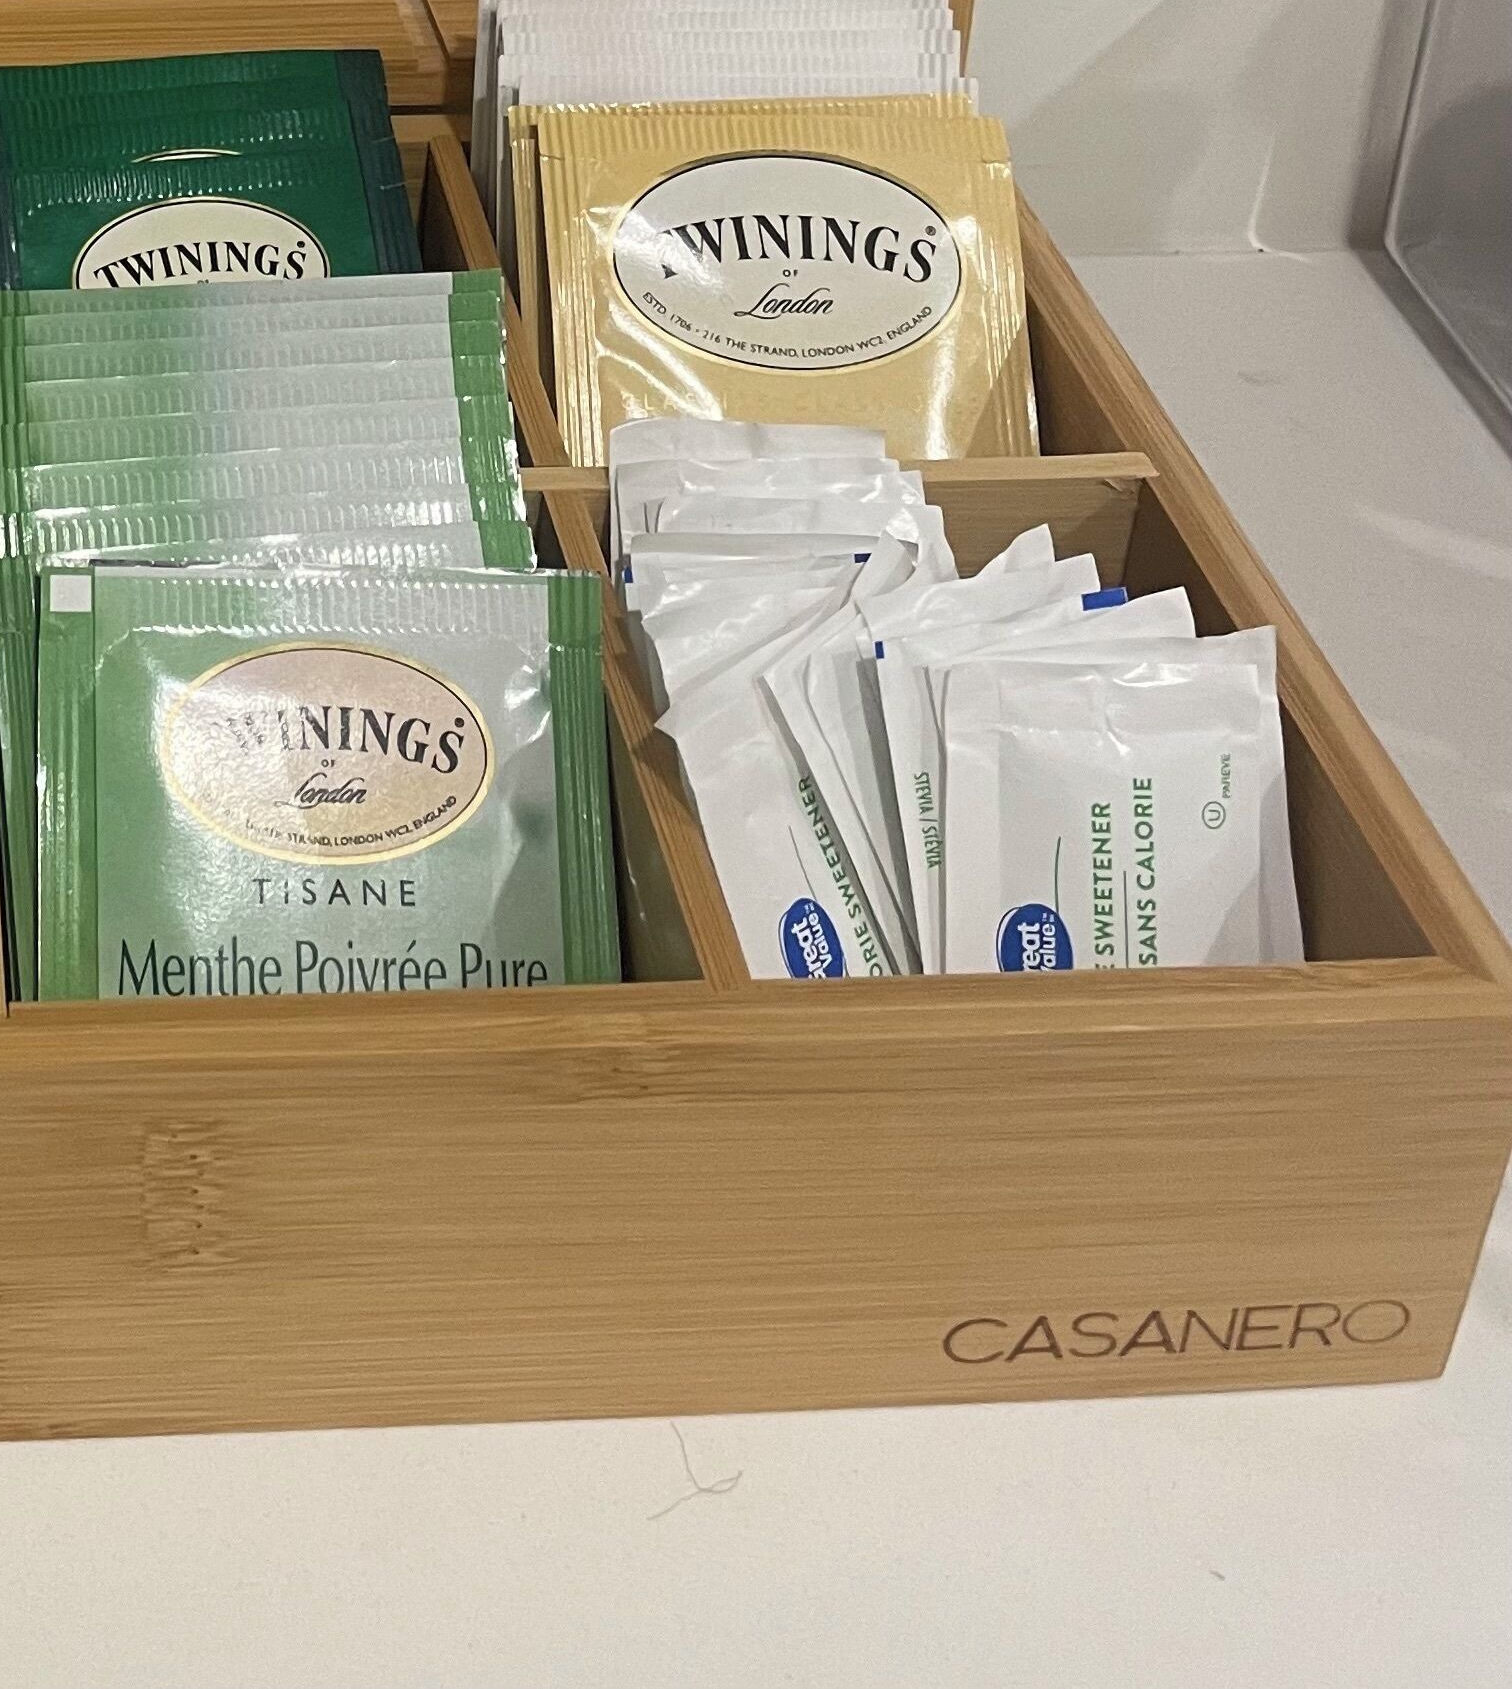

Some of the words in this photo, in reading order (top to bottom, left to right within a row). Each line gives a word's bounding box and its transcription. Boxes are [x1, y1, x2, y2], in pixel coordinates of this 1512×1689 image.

[783, 269, 799, 277] OF
[733, 282, 834, 319] London
[669, 313, 692, 331] 1706
[702, 329, 721, 344] 216
[725, 336, 747, 351] THE
[801, 344, 855, 358] LONDON
[886, 306, 932, 340] ENGLAND
[321, 759, 336, 768] OF
[274, 772, 367, 809] London
[914, 772, 934, 815] STEVIA
[335, 832, 384, 846] LONDON
[413, 795, 457, 830] ENGLAND
[1133, 777, 1155, 891] CALORIE
[798, 775, 861, 919] SWEETENER
[252, 878, 416, 907] TISANE
[1091, 802, 1114, 956] SWEETENER
[809, 912, 833, 969] Value
[1137, 898, 1158, 966] SANS
[118, 935, 282, 997] Menthe
[296, 939, 447, 995] Poivrée
[460, 942, 548, 989] Pure
[942, 1299, 1410, 1364] CASANERO
